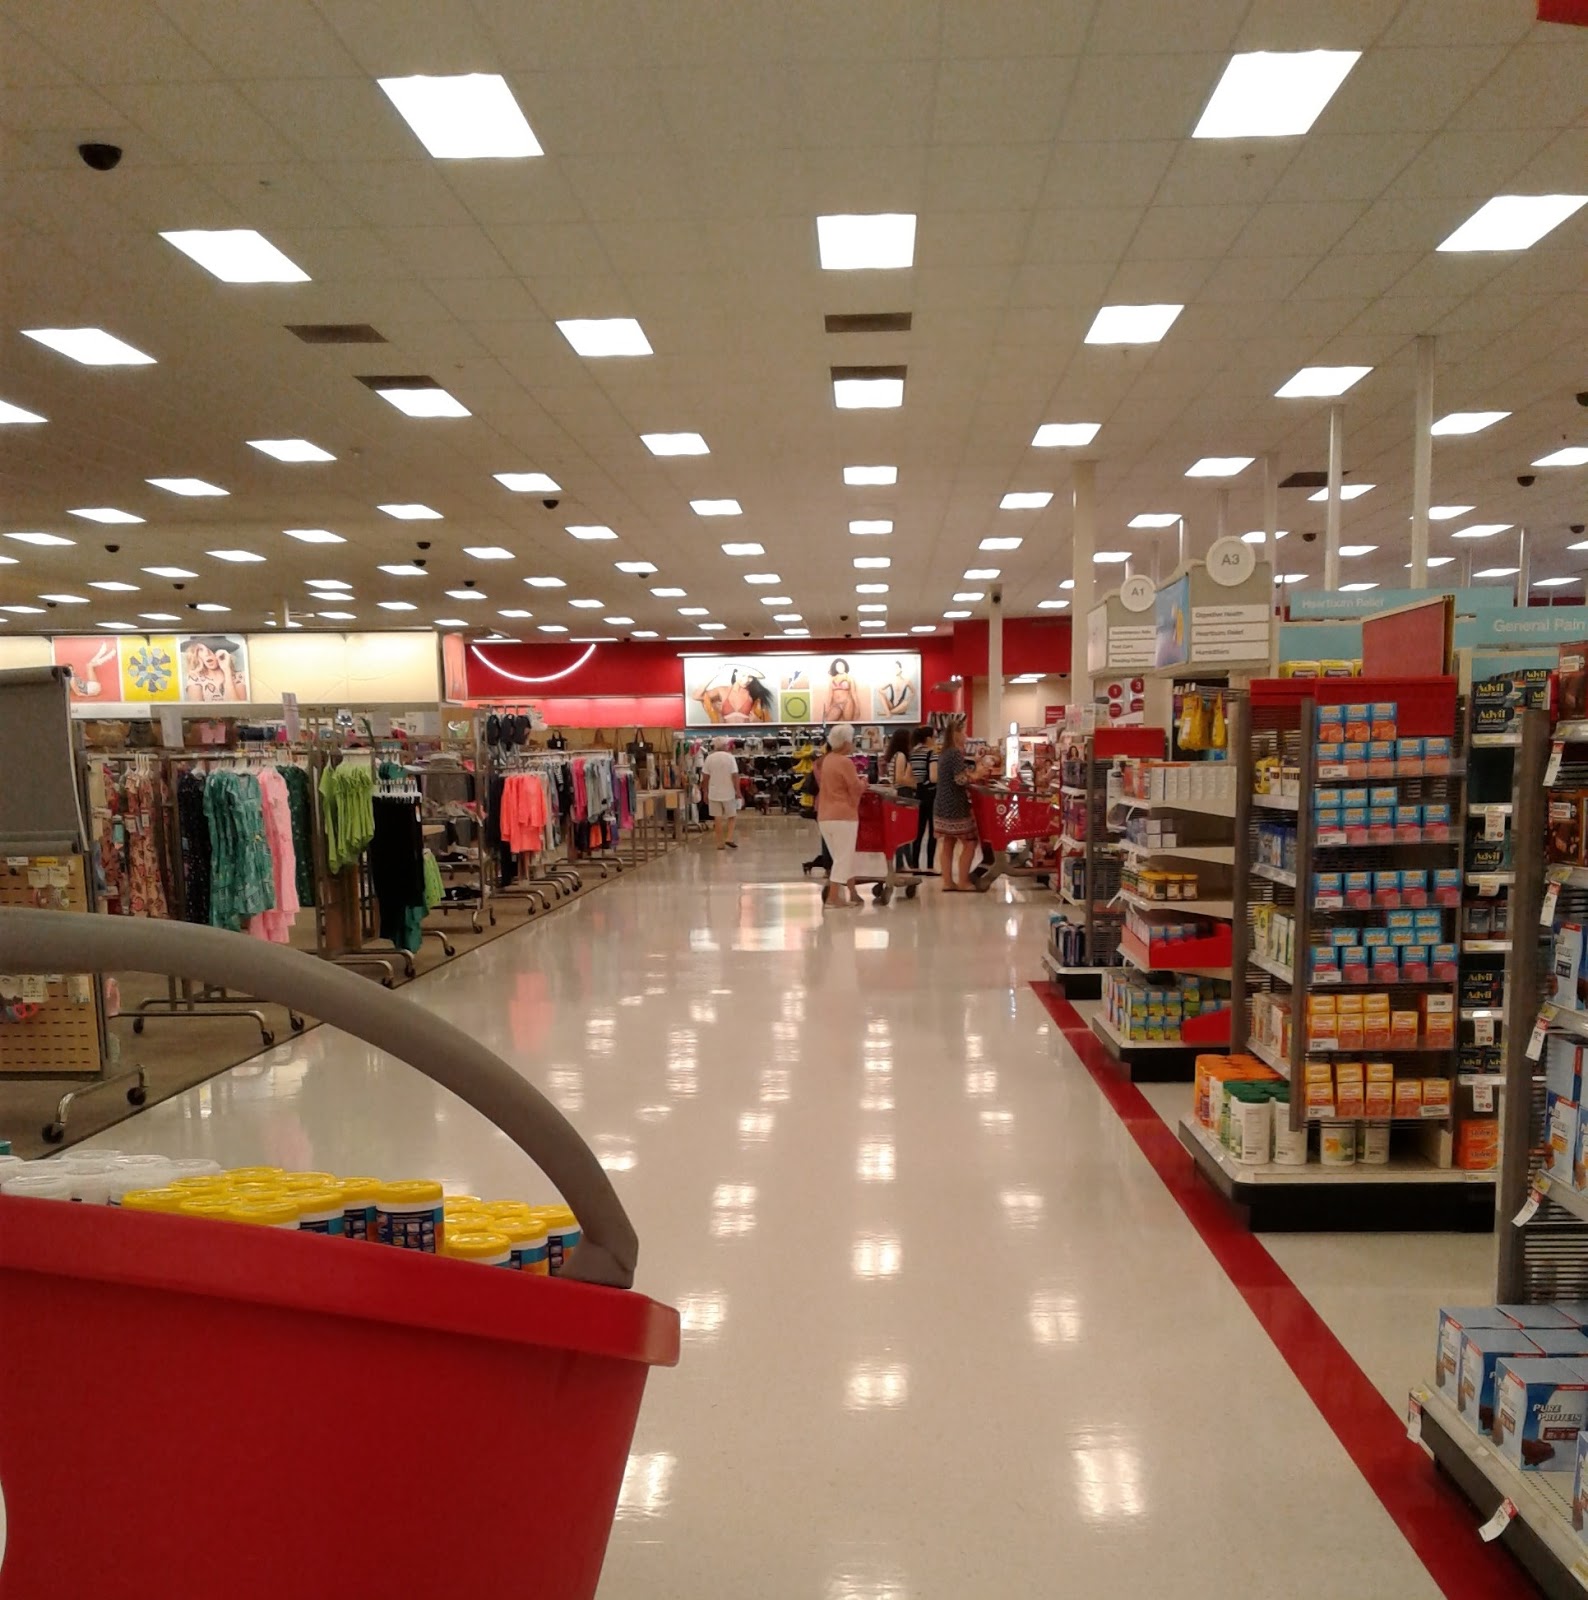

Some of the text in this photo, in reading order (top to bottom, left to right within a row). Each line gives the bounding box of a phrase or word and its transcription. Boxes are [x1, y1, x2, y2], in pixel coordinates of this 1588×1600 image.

[1221, 554, 1240, 566] A3
[1131, 587, 1145, 596] A1
[1494, 618, 1585, 632] General Pain
[1478, 682, 1504, 693] Advil
[1480, 709, 1506, 720] Advil
[1475, 851, 1500, 861] Advil
[1468, 973, 1493, 981] Advil
[1466, 990, 1492, 999] Advil
[1533, 1404, 1562, 1414] PURE
[1537, 1413, 1583, 1421] PROTEIN
